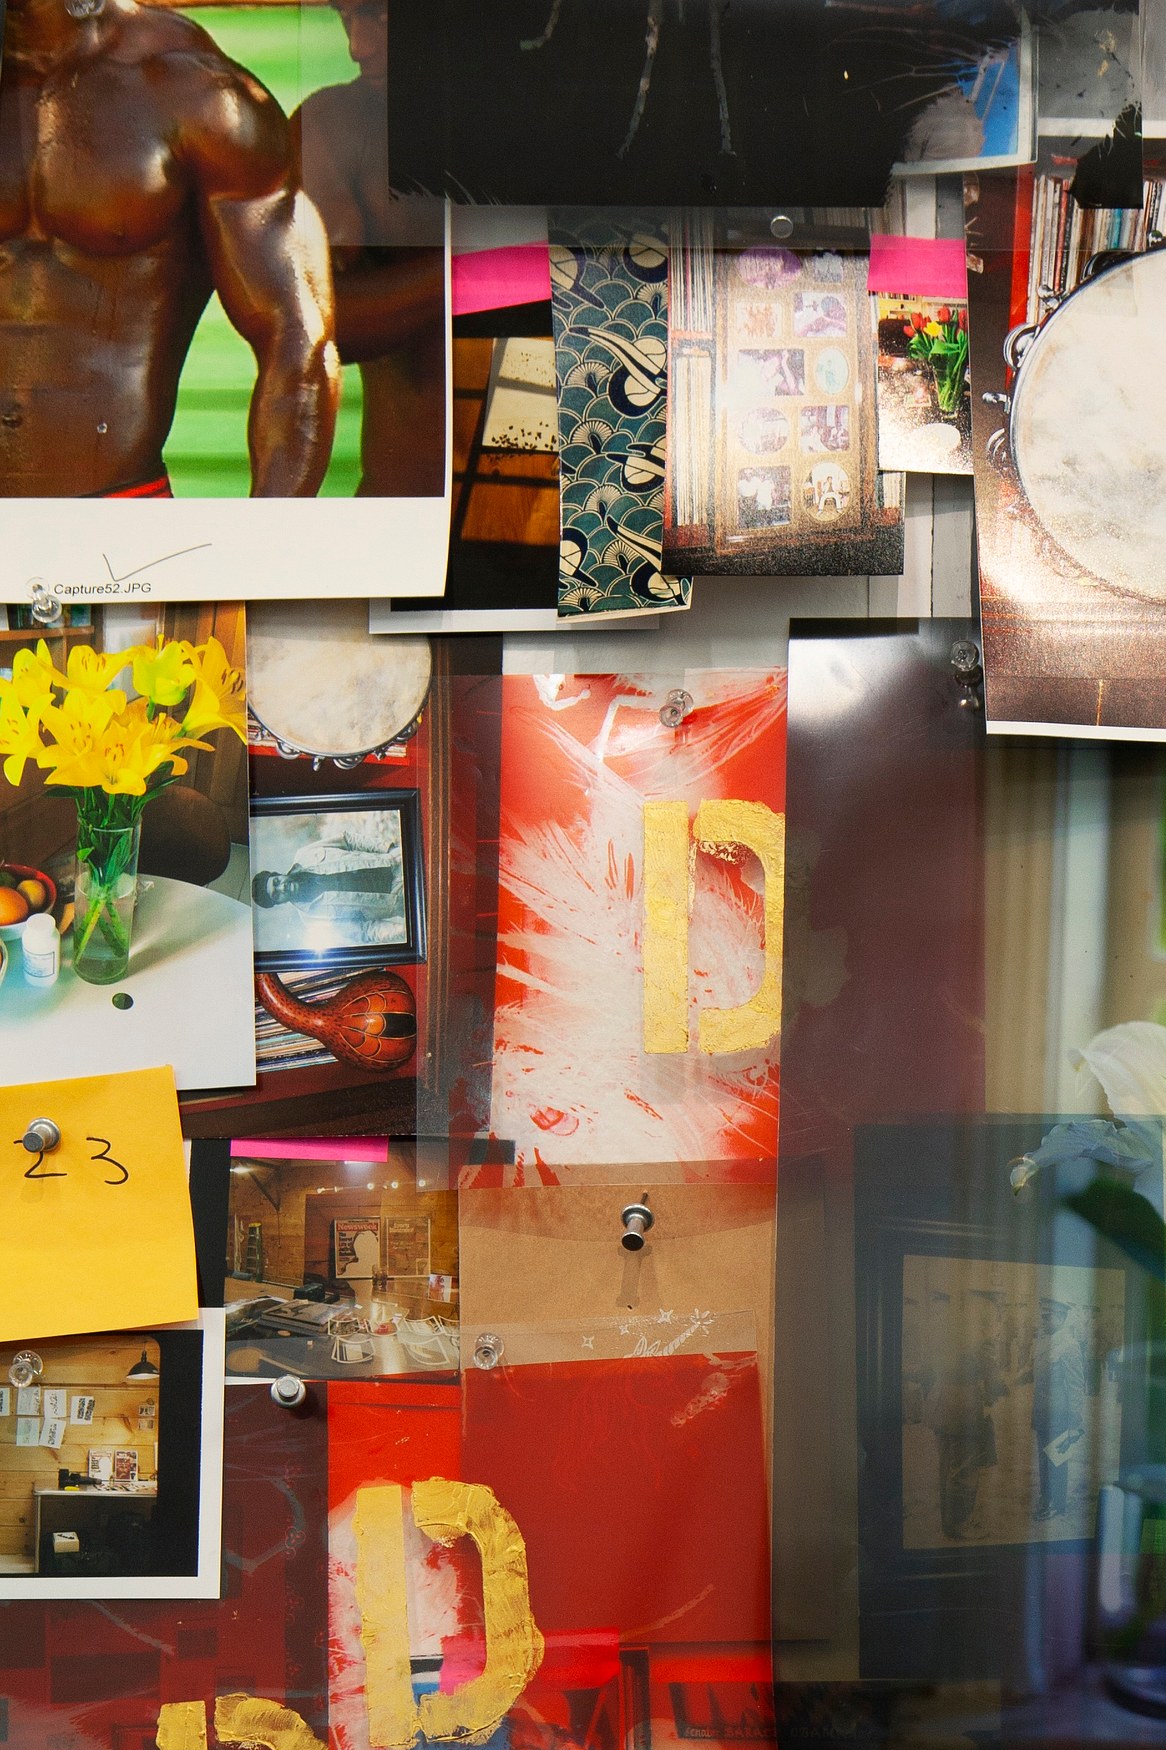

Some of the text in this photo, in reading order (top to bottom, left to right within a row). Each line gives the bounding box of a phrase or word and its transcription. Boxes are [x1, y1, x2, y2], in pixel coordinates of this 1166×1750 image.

[53, 582, 151, 596] Capture52.JPG
[337, 1223, 377, 1231] Newsweek
[354, 1477, 545, 1750] D
